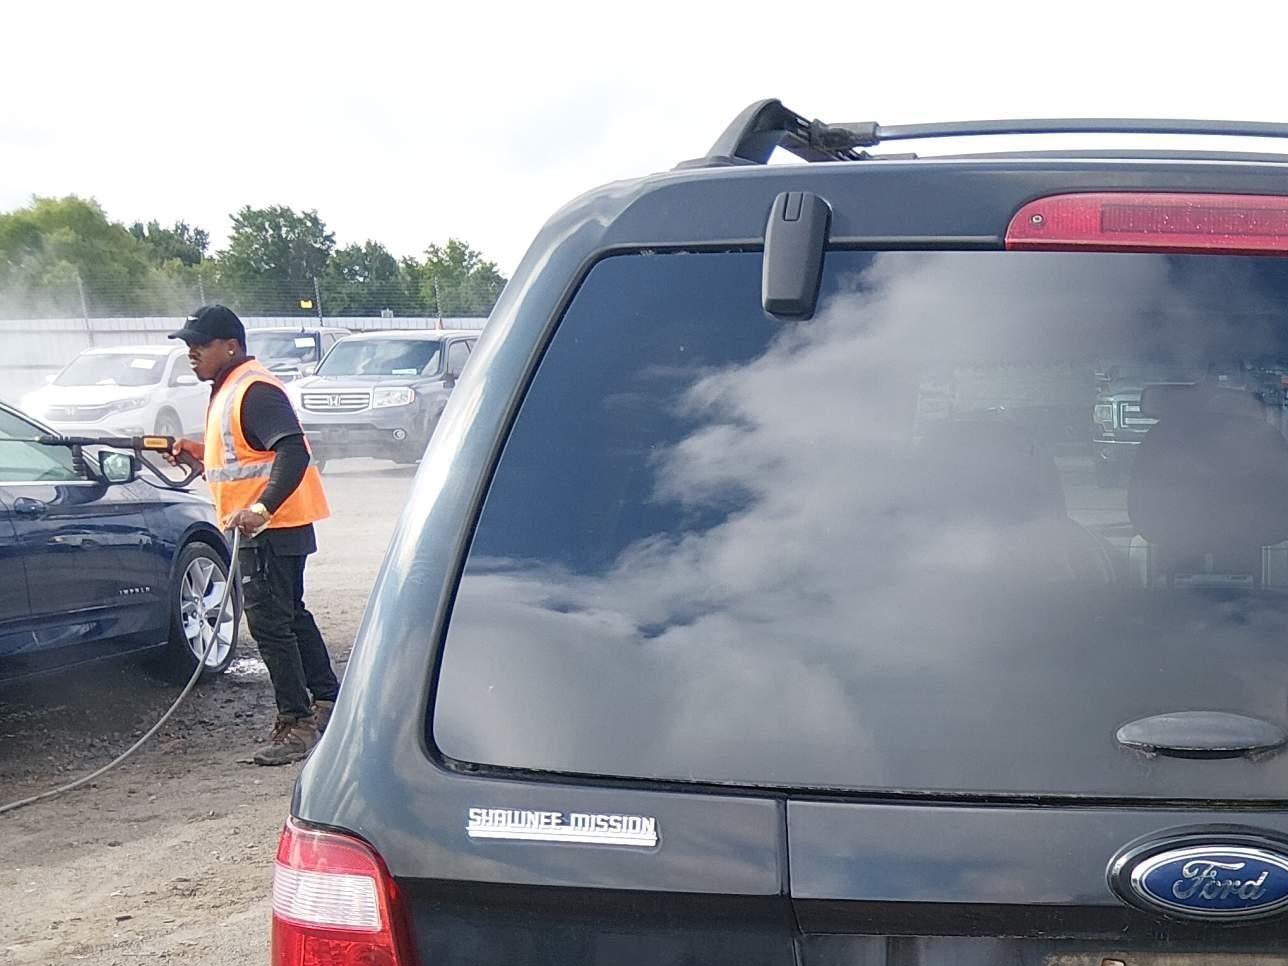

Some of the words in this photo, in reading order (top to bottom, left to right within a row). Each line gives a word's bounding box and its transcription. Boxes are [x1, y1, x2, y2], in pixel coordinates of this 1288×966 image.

[468, 807, 564, 830] SHAWNEE
[569, 812, 656, 835] MISSION
[1172, 859, 1270, 901] Ford
